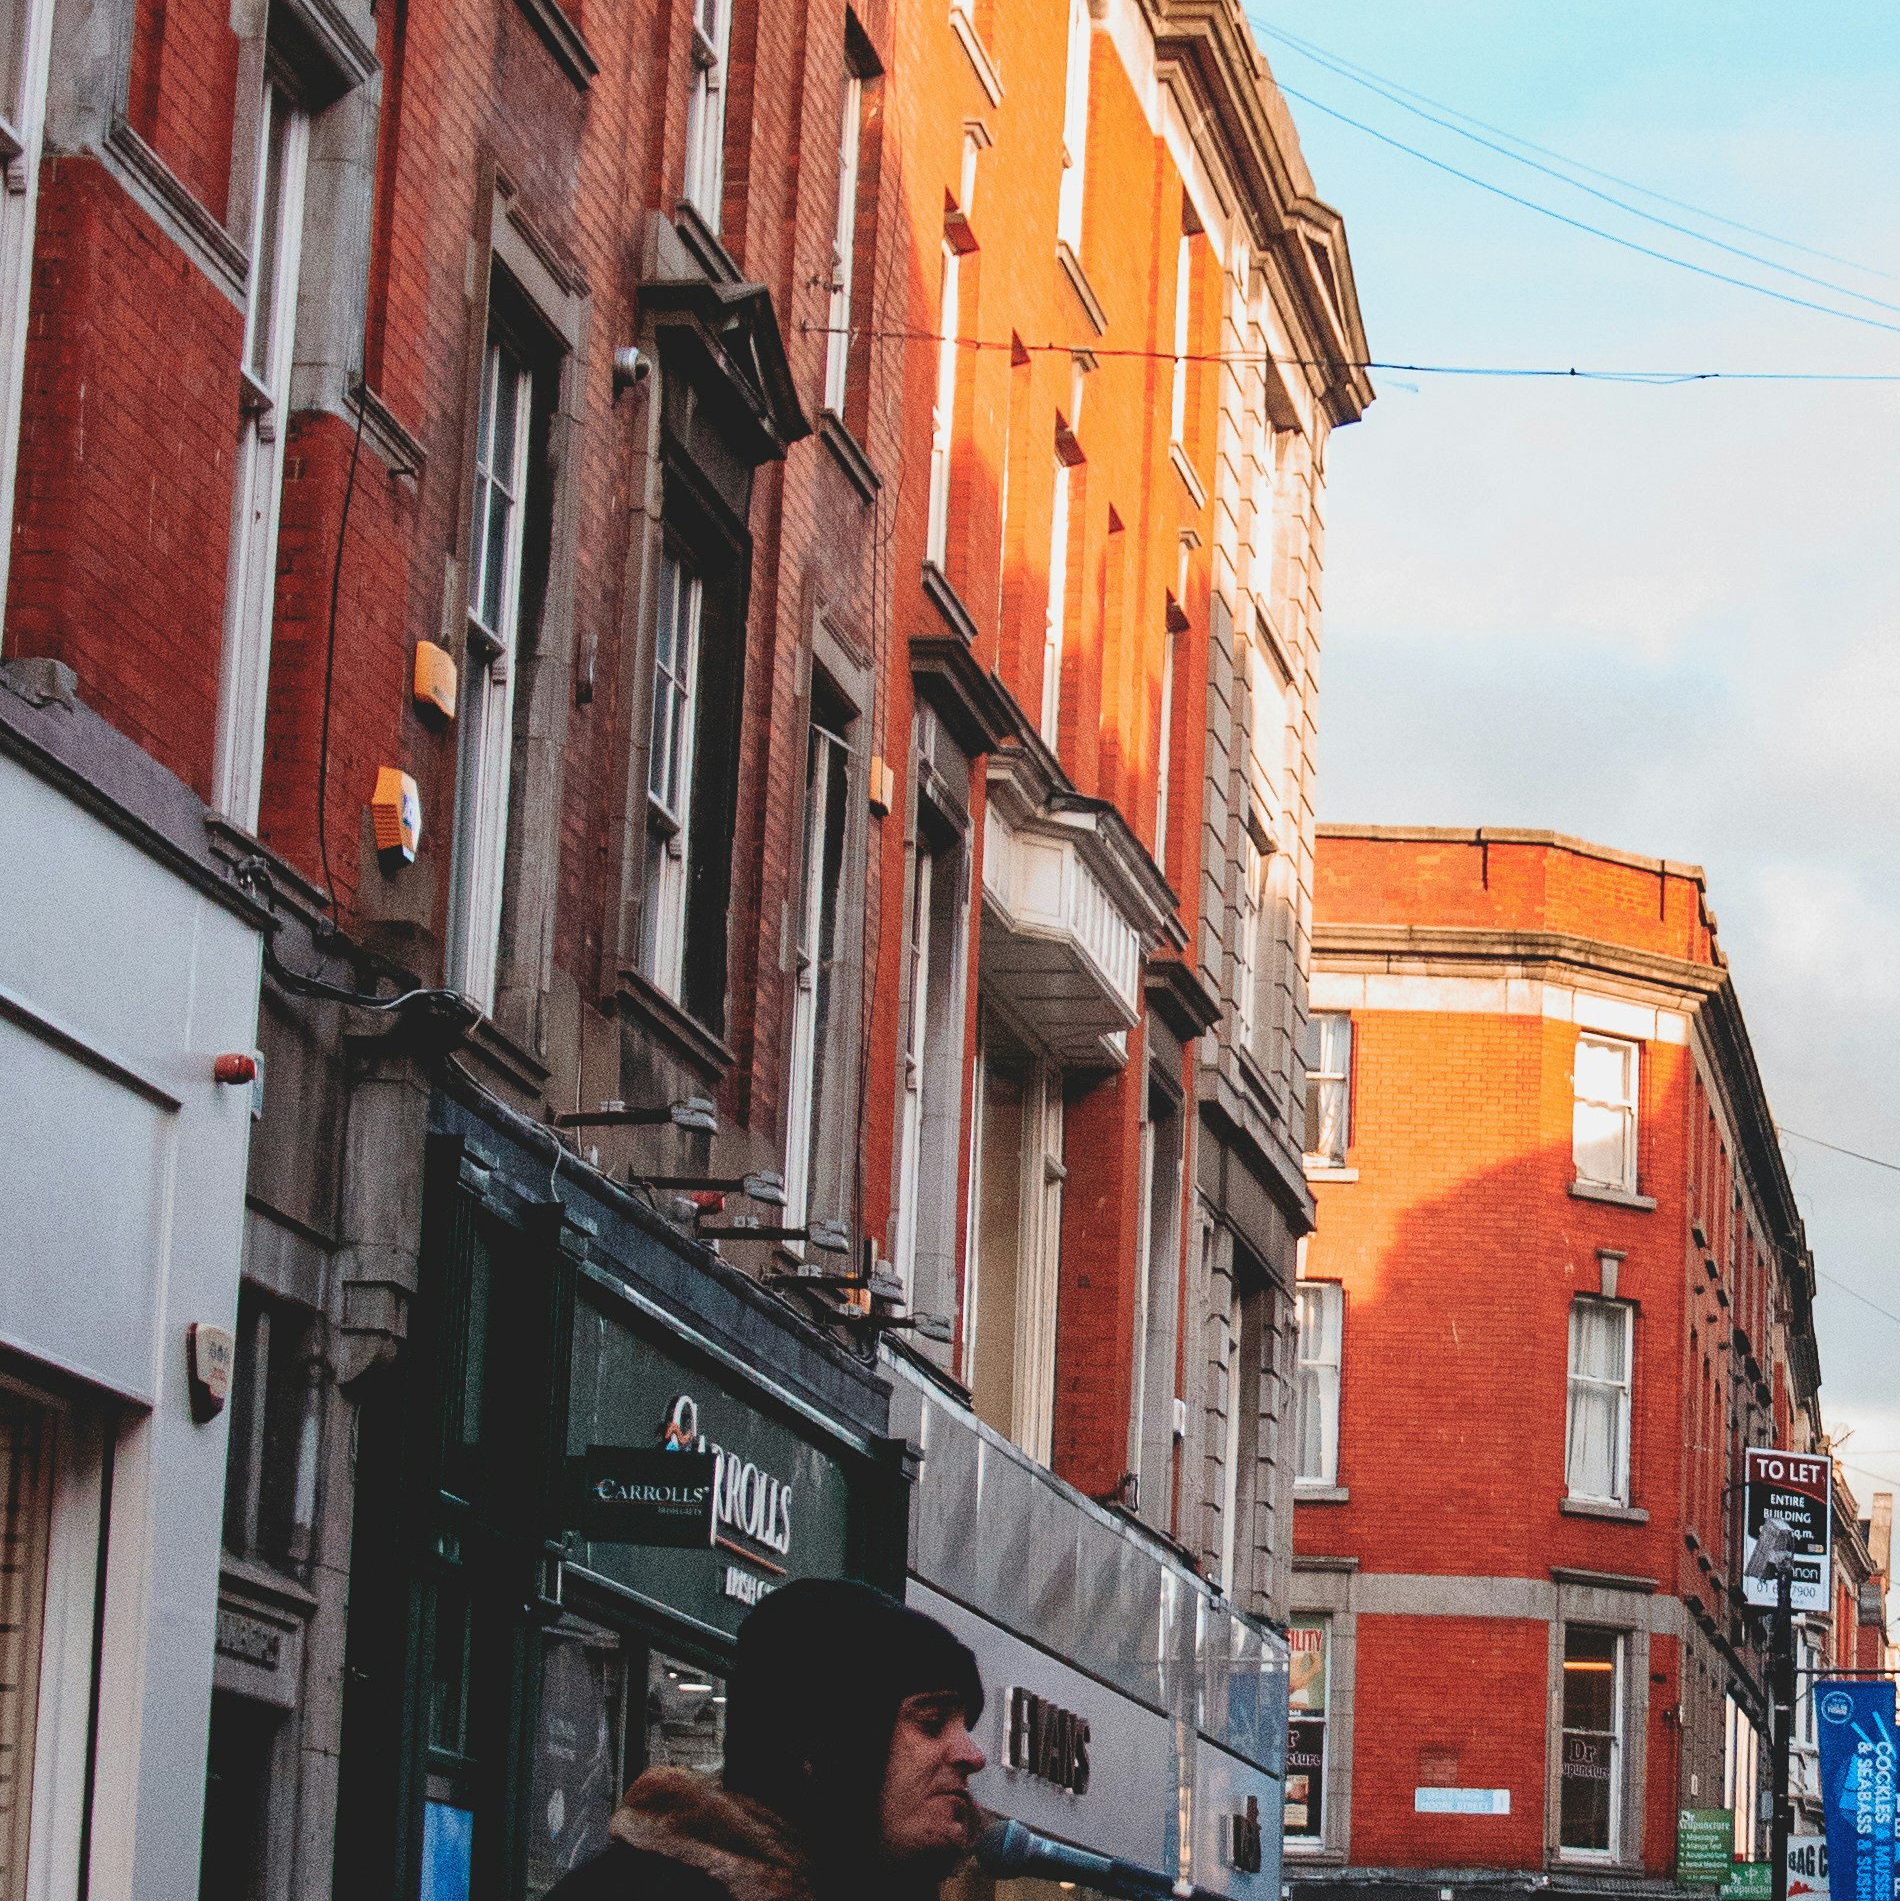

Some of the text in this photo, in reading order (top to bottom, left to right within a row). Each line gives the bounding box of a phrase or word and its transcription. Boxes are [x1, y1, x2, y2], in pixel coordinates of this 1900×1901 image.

[1757, 1459, 1820, 1483] TO LET
[595, 1478, 703, 1503] CARROLLS
[1770, 1493, 1805, 1508] ENTIRE
[1763, 1507, 1811, 1524] BUILDING
[1002, 1686, 1091, 1795] EVANS
[1570, 1738, 1597, 1763] Dr
[1857, 1741, 1873, 1755] &
[1876, 1741, 1892, 1823] COCKLES
[1857, 1758, 1872, 1834] SEABASS
[1788, 1845, 1816, 1877] BAG
